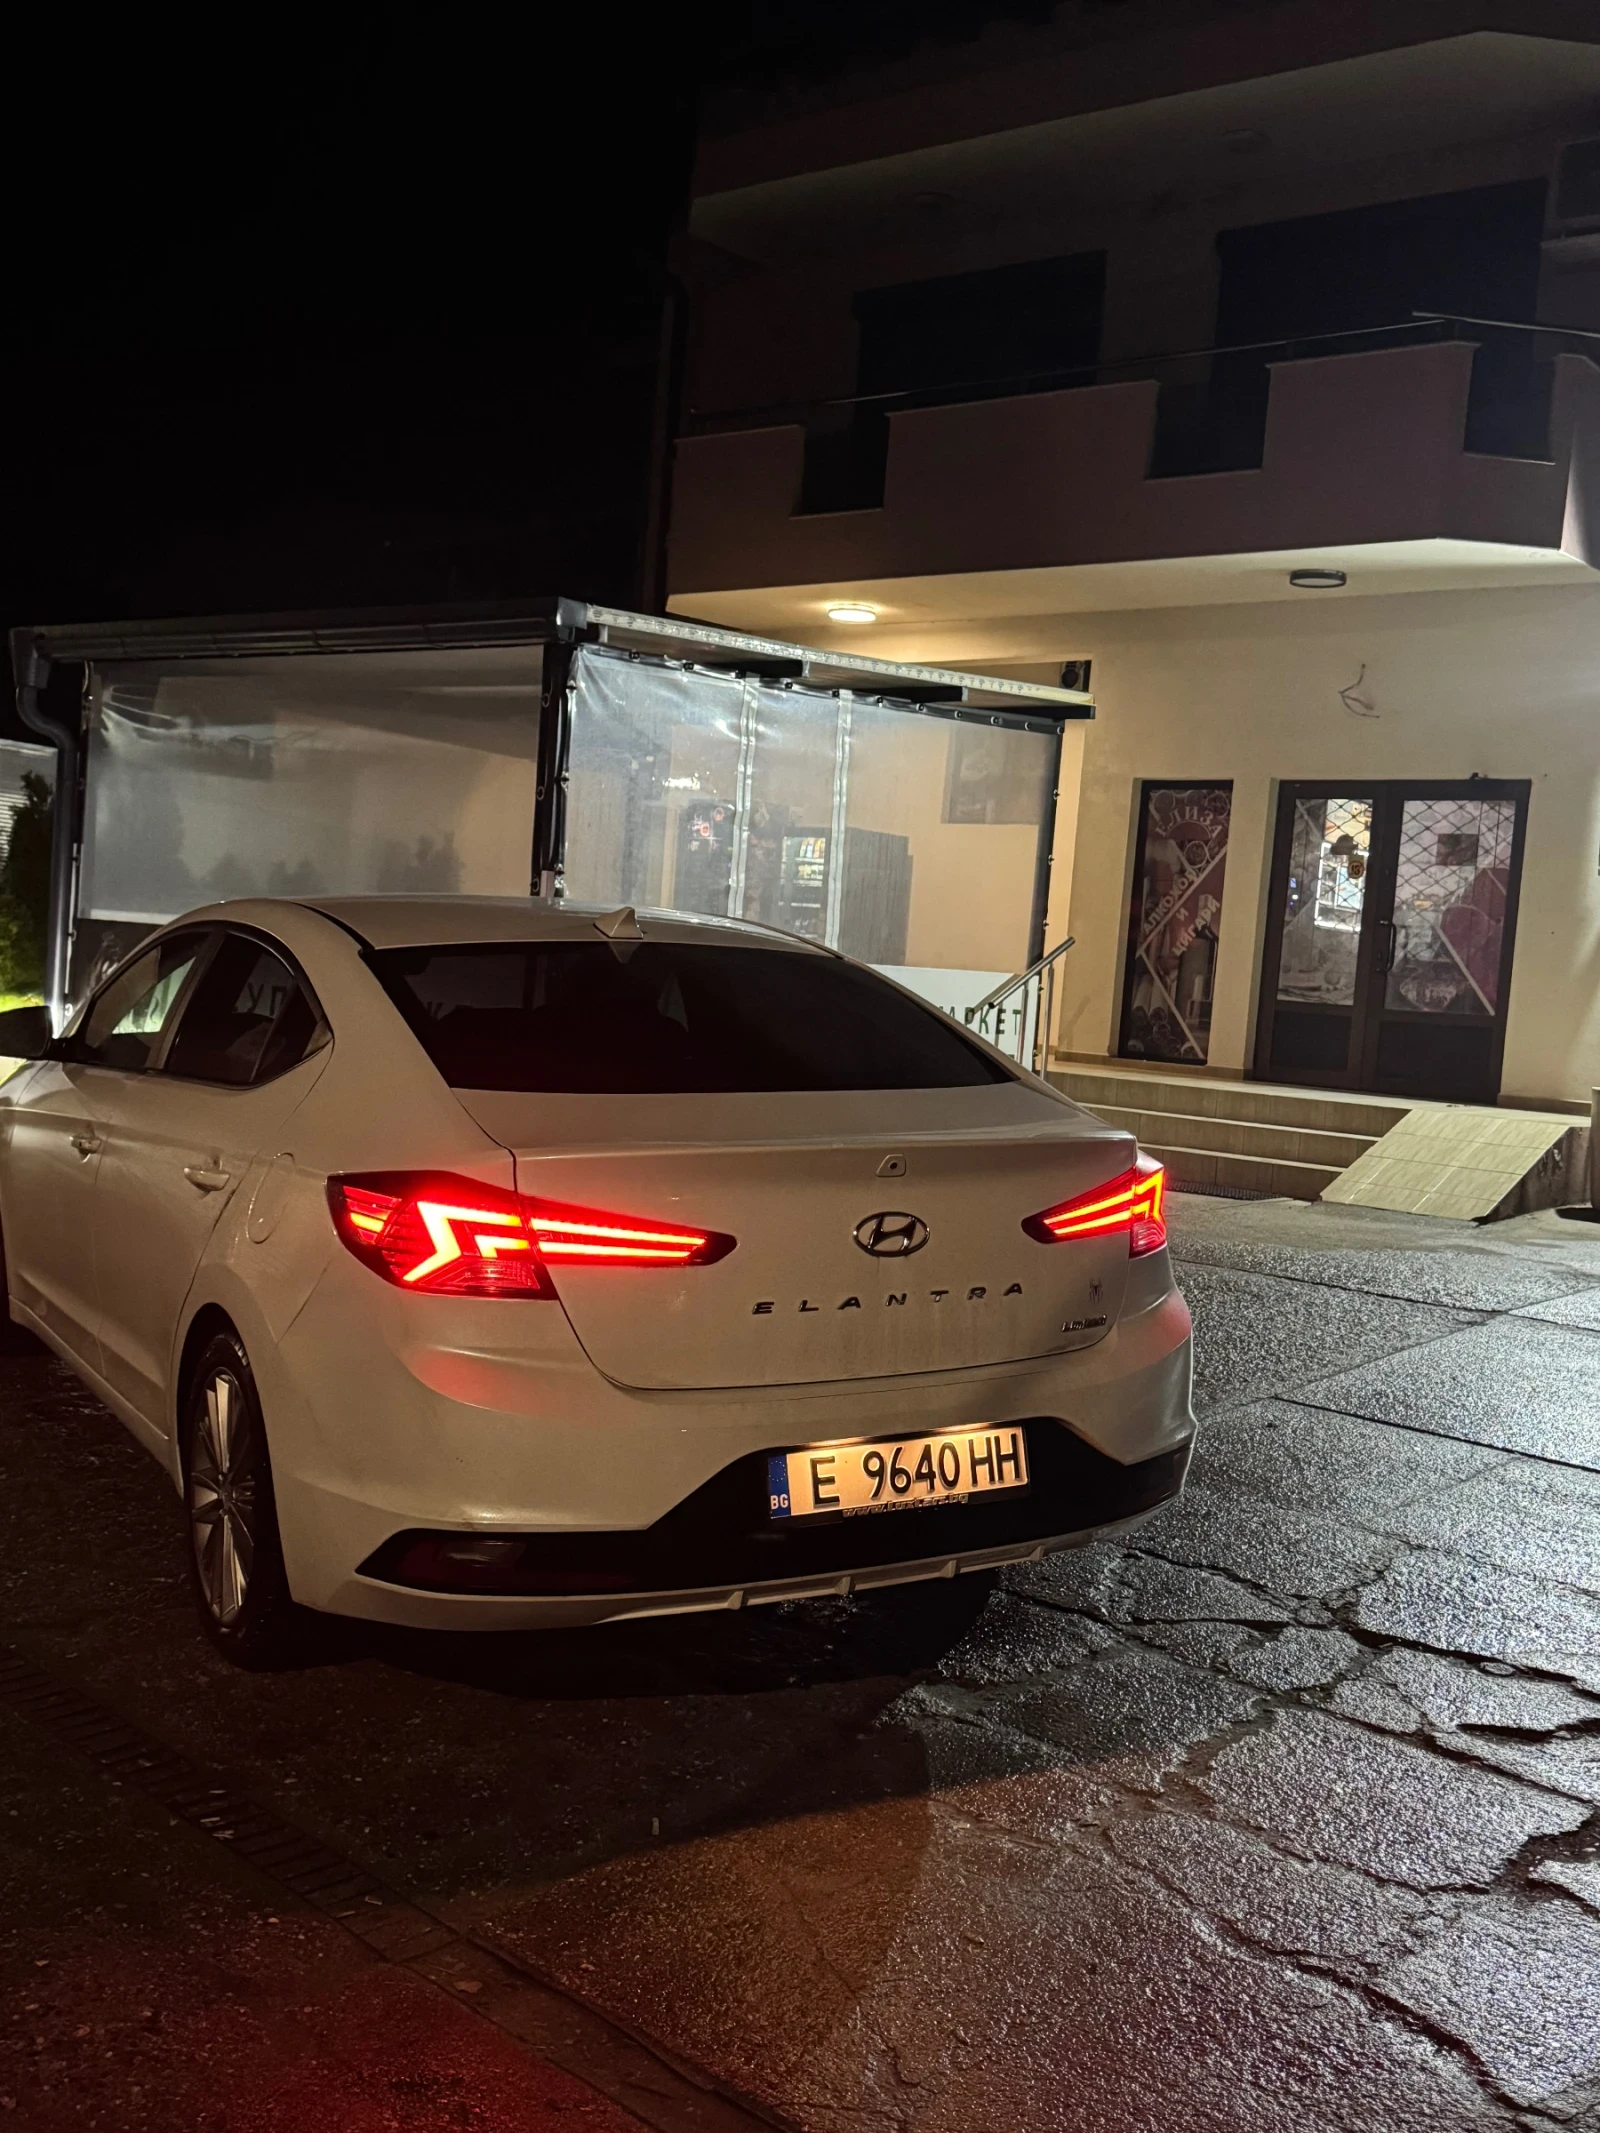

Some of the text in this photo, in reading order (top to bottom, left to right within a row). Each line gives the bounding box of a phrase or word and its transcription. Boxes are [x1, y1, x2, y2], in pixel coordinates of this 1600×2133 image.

[1155, 806, 1223, 838] ЕЛИЗА
[752, 1282, 1024, 1315] ELANTRA
[810, 1433, 1021, 1508] E 9640 HH
[769, 1494, 790, 1511] BG
